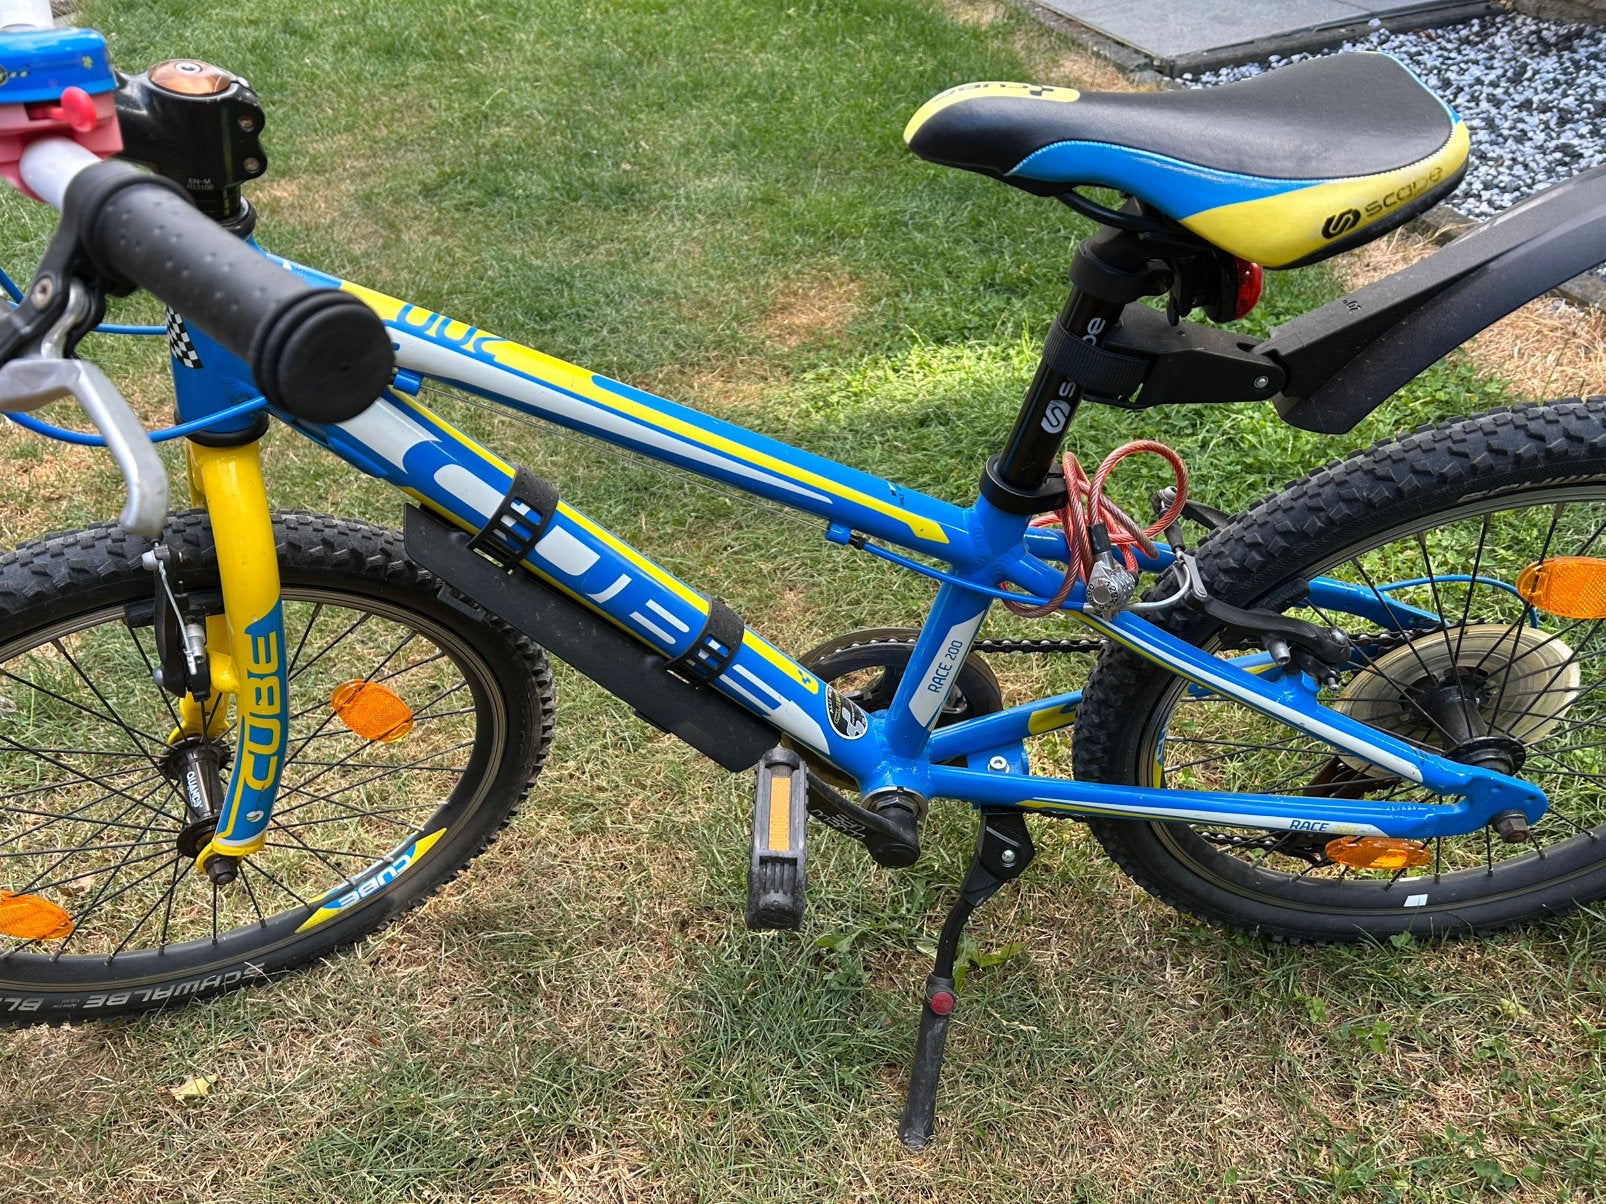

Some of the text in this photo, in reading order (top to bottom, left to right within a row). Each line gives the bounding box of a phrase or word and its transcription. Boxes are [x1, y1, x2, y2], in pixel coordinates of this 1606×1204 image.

[927, 640, 963, 693] RACE 200
[245, 631, 282, 791] CUBE
[186, 770, 202, 808] QUANDO
[1289, 819, 1330, 832] RACE
[337, 854, 412, 909] CUBE
[82, 961, 266, 1009] SCHWALBE
